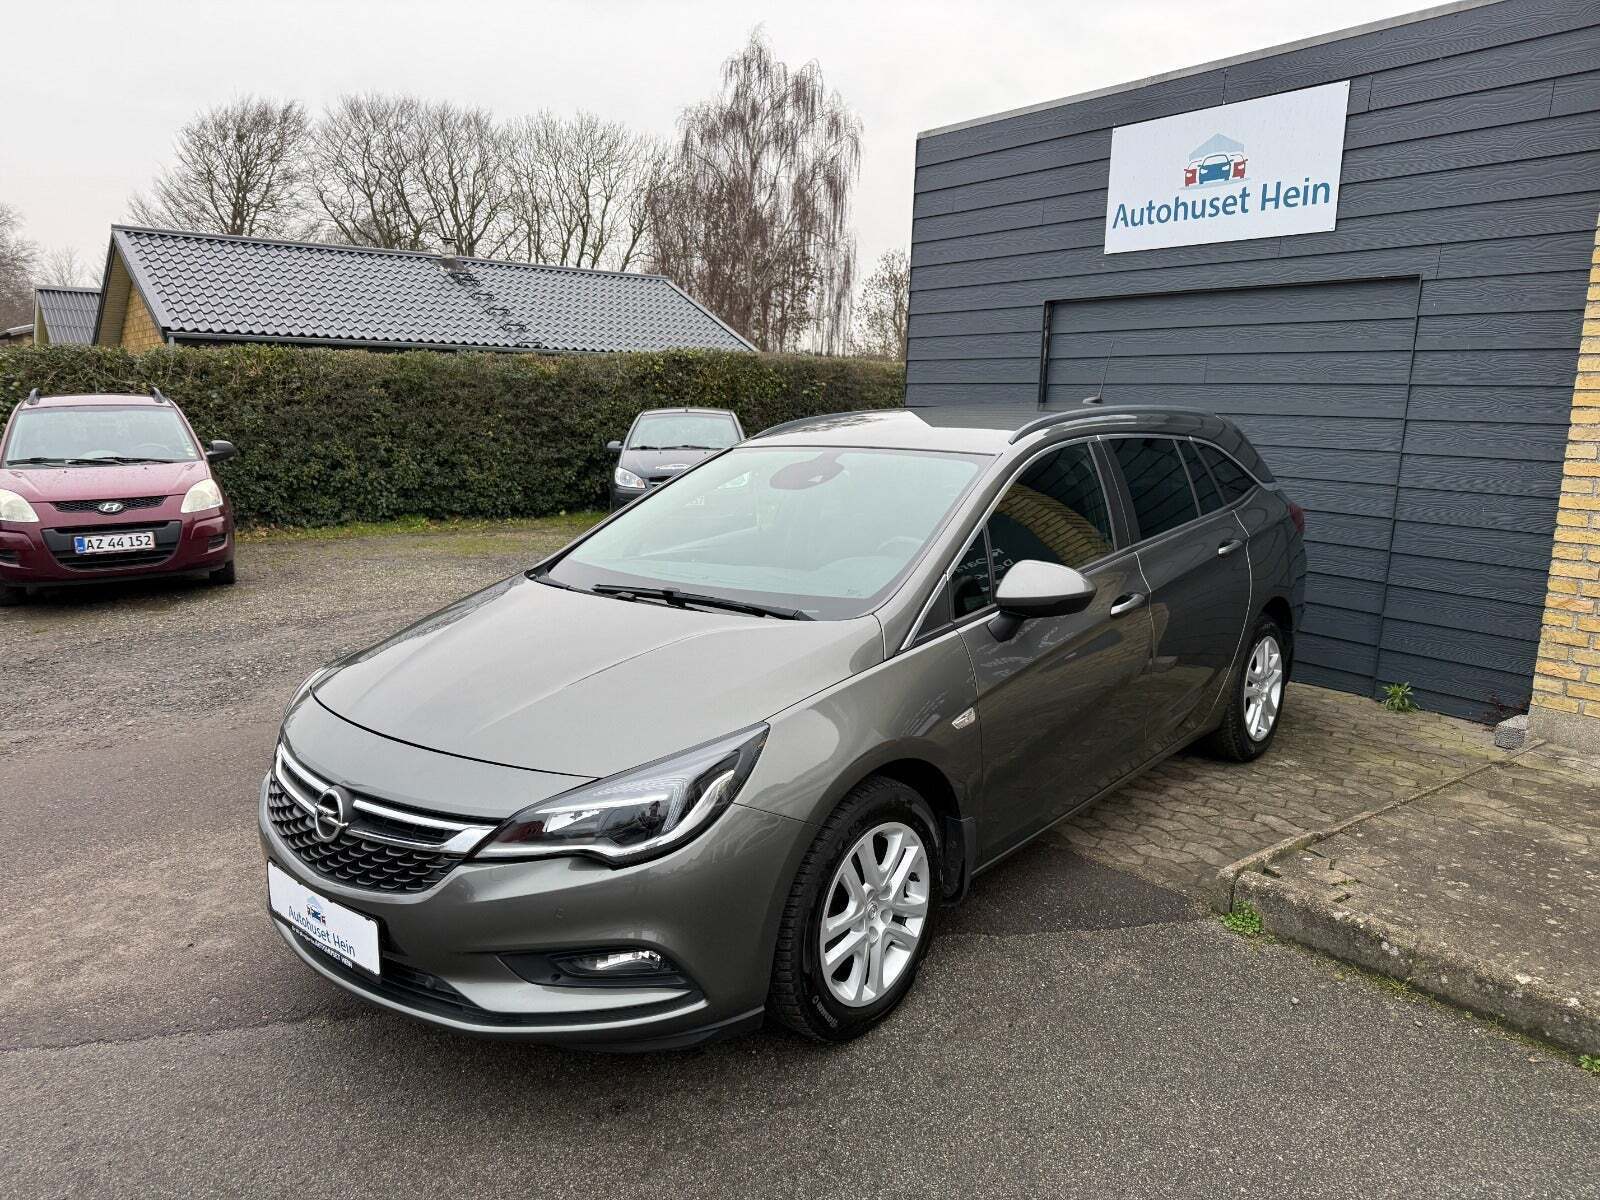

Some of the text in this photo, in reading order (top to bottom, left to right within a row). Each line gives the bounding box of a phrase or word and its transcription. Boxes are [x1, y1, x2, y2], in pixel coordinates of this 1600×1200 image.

[1112, 177, 1331, 229] Autohuset Hein
[86, 538, 104, 551] AZ
[108, 537, 124, 548] 44
[128, 535, 151, 547] 152
[288, 905, 332, 943] Autohuset
[332, 931, 356, 958] Hein
